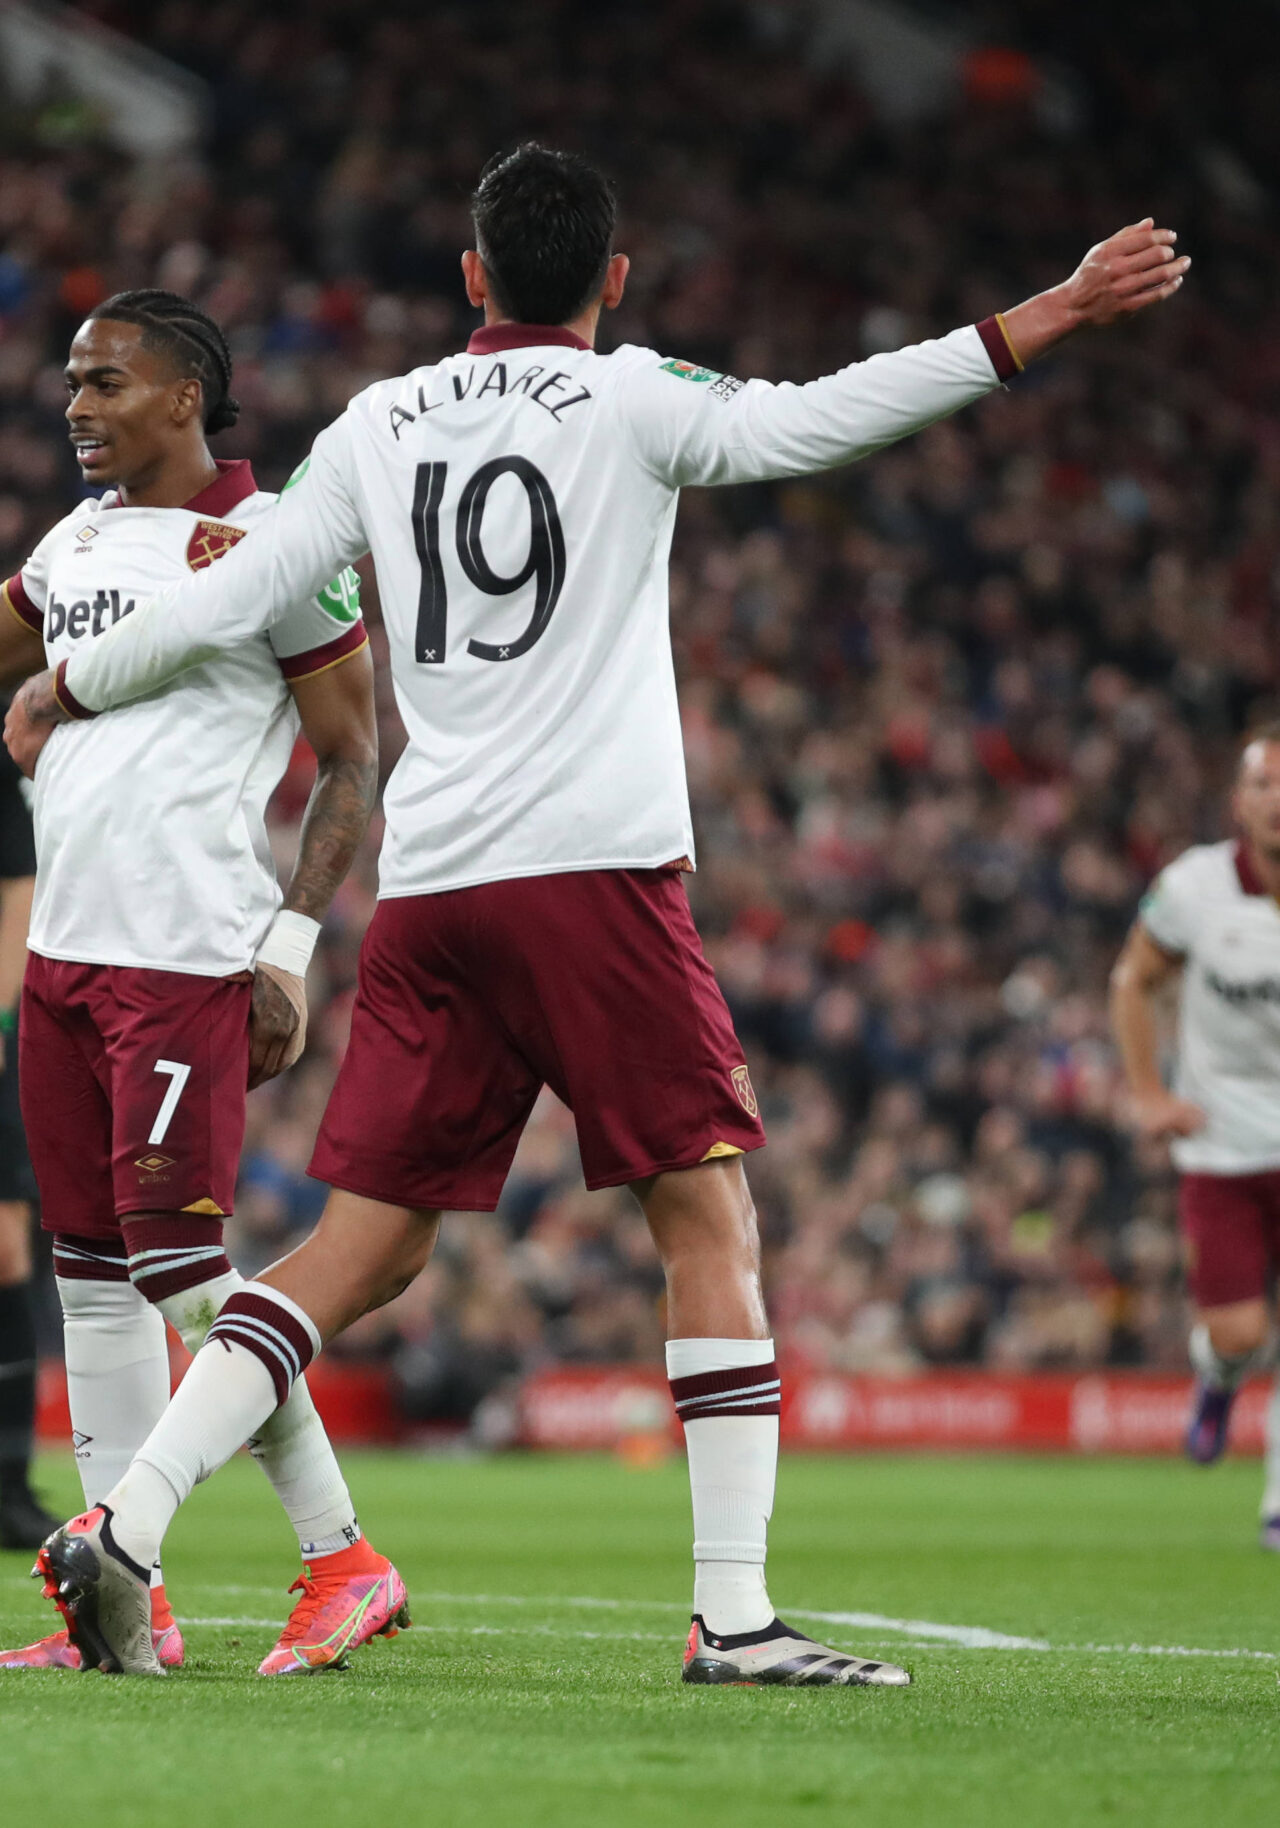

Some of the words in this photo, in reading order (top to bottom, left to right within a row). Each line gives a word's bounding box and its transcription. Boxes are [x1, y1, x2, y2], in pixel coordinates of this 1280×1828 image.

[201, 522, 221, 531] WEST
[411, 454, 567, 664] 19
[147, 1058, 192, 1145] 7
